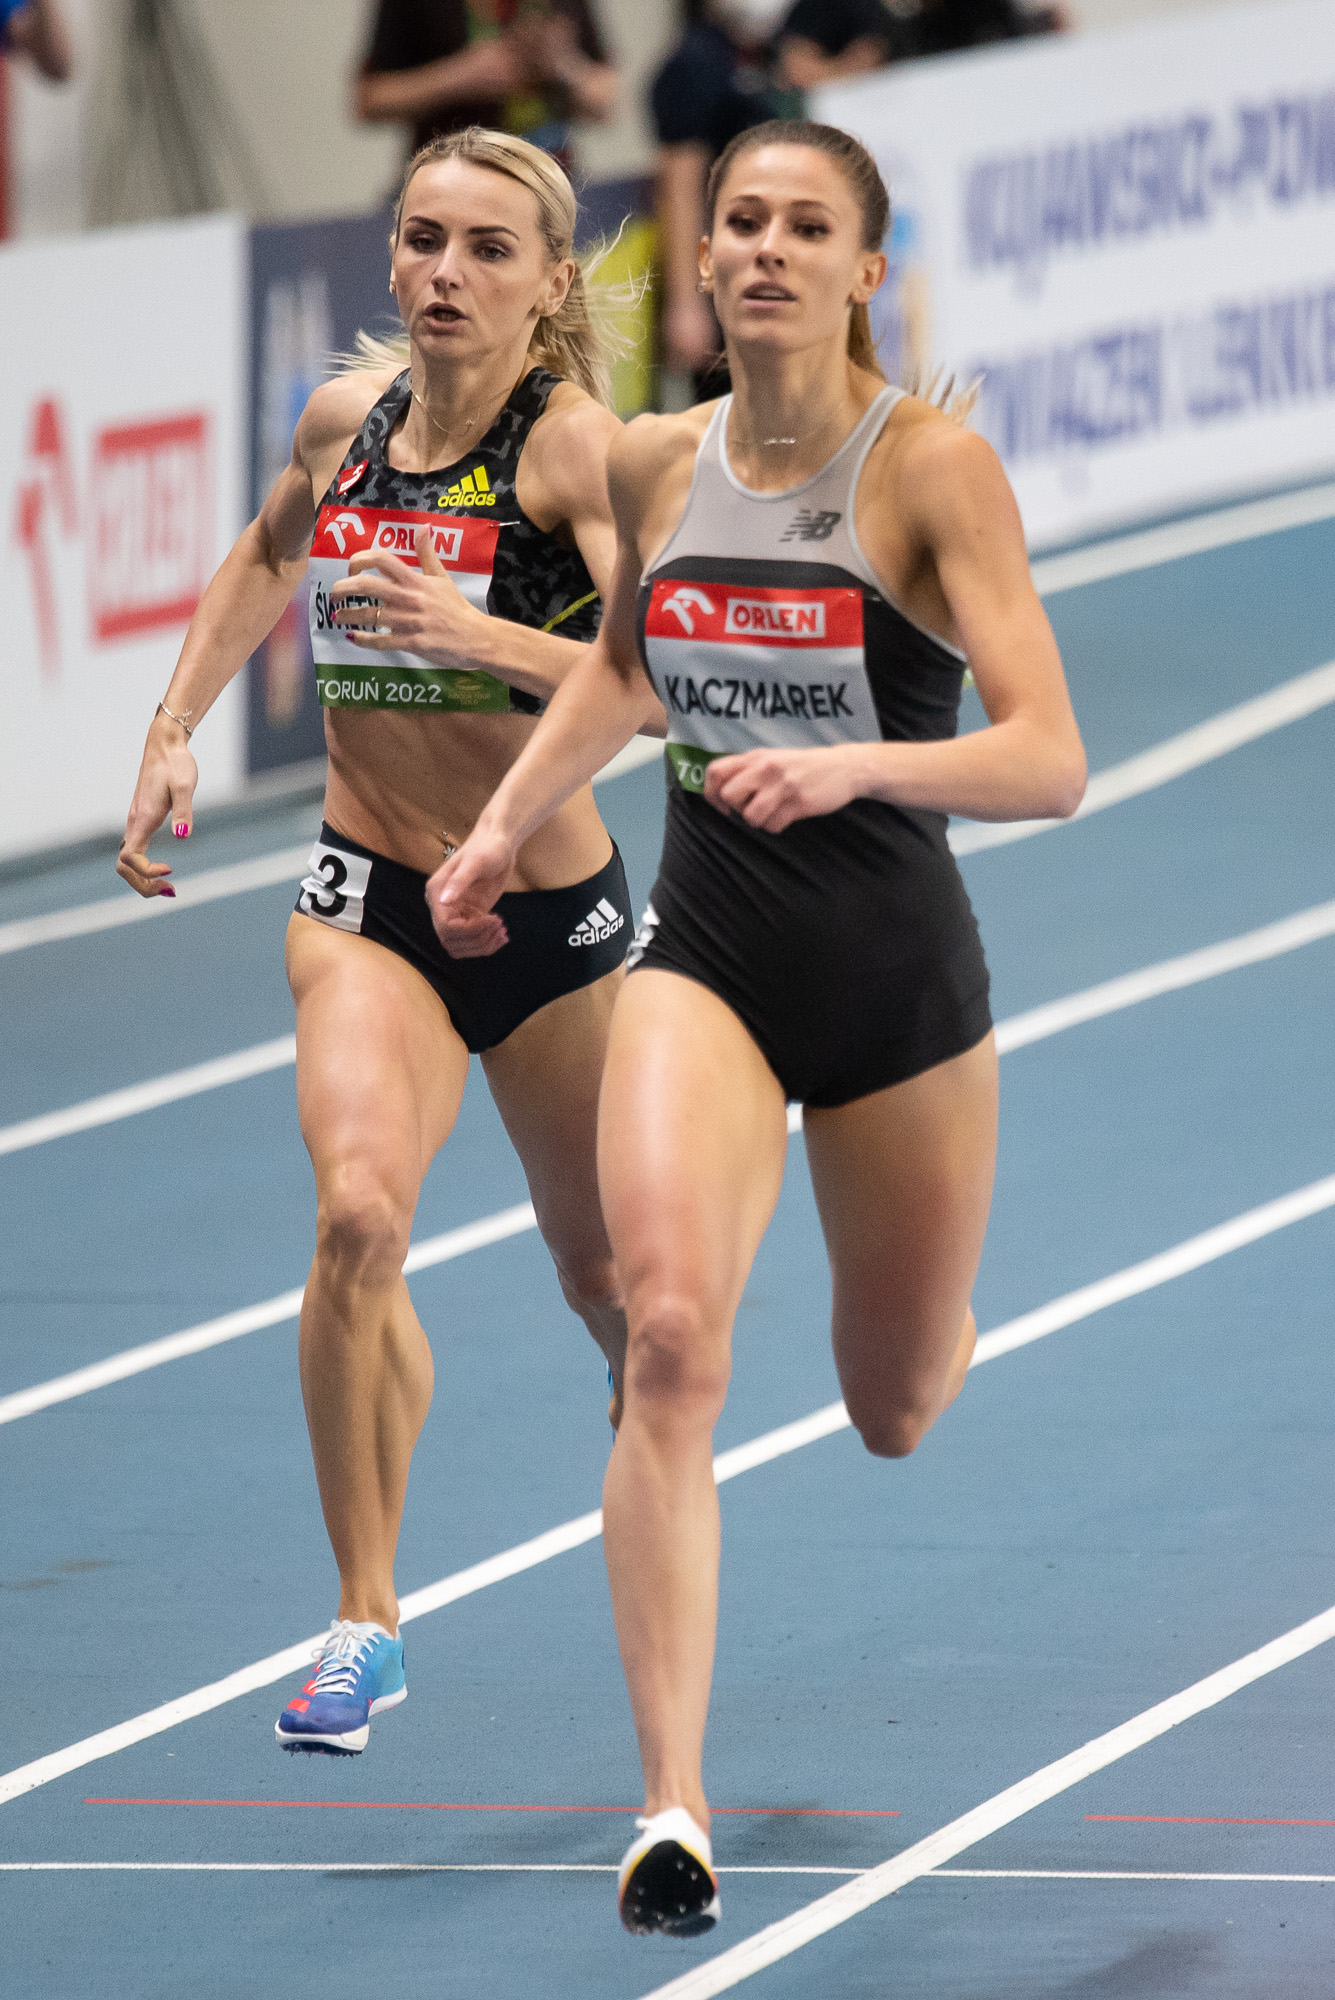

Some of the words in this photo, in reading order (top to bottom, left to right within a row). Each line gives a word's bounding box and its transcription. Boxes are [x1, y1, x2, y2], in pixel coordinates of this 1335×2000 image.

[438, 490, 497, 507] adidas
[378, 526, 456, 555] ORLN
[733, 604, 817, 632] ORLEN
[316, 677, 379, 701] TORUŃ
[385, 683, 442, 703] 2022
[664, 674, 854, 720] KACZMAREK
[310, 854, 348, 918] 3
[567, 914, 625, 947] adidas
